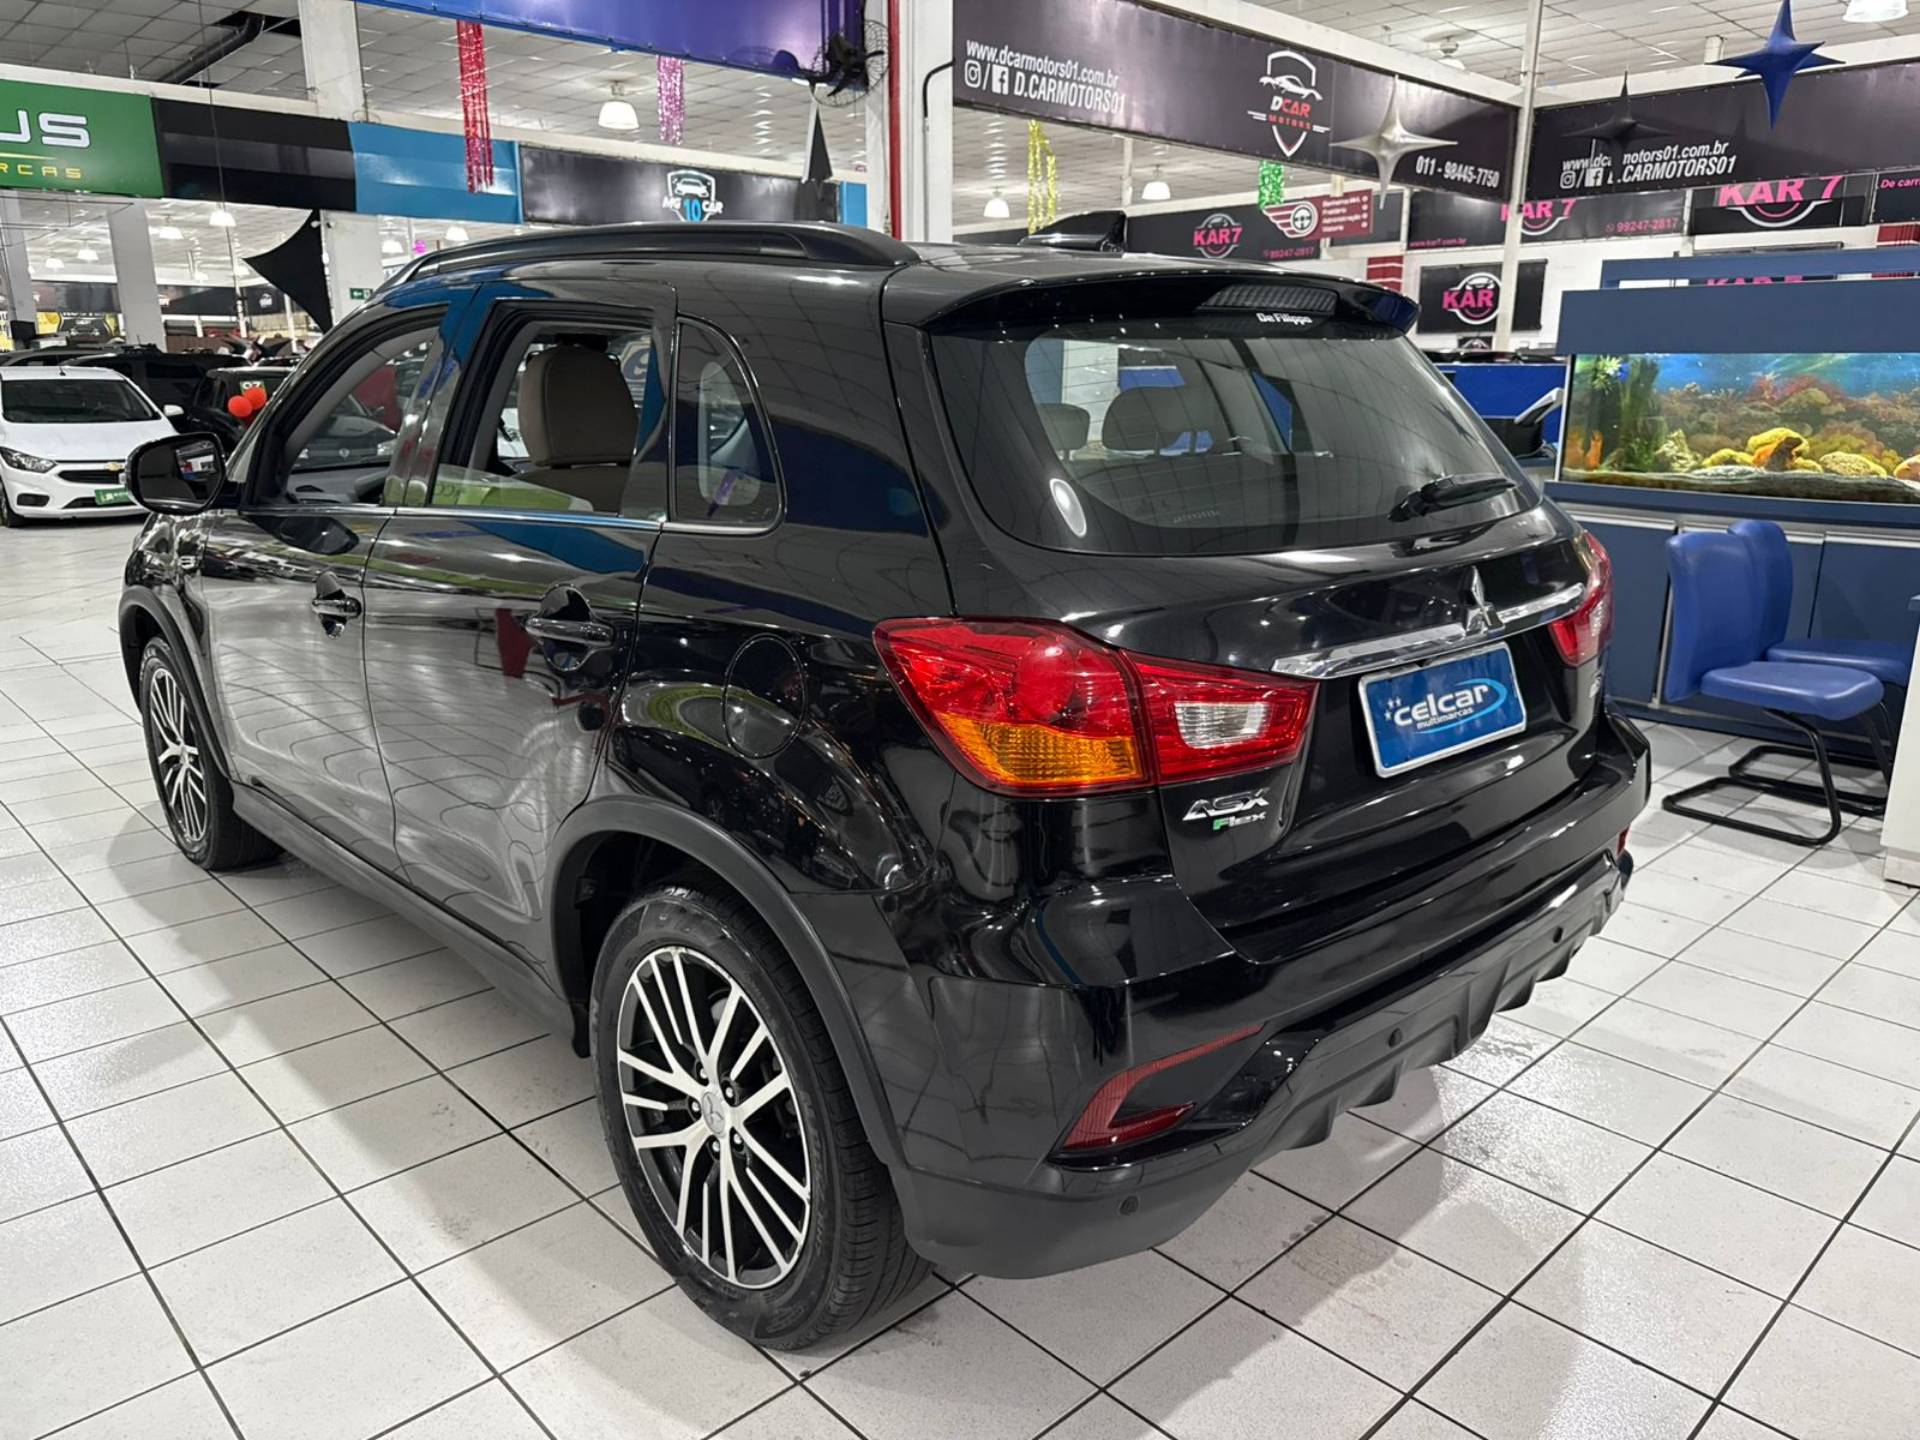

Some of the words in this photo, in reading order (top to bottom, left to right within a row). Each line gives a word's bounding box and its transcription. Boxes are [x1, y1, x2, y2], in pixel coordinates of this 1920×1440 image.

[966, 40, 1119, 89] www.dcarmotors01.com.br
[1014, 71, 1127, 115] D.CARMOTORS01
[1270, 95, 1311, 118] DCAR
[1415, 155, 1436, 176] 011
[1718, 178, 1805, 207] KAR
[1820, 175, 1844, 200] 7
[1561, 198, 1577, 217] 7
[1443, 289, 1494, 309] KAR
[1394, 684, 1489, 727] celcar
[1416, 706, 1475, 730] multimarcas
[1182, 787, 1270, 821] ASX
[1213, 811, 1267, 831] Flex
